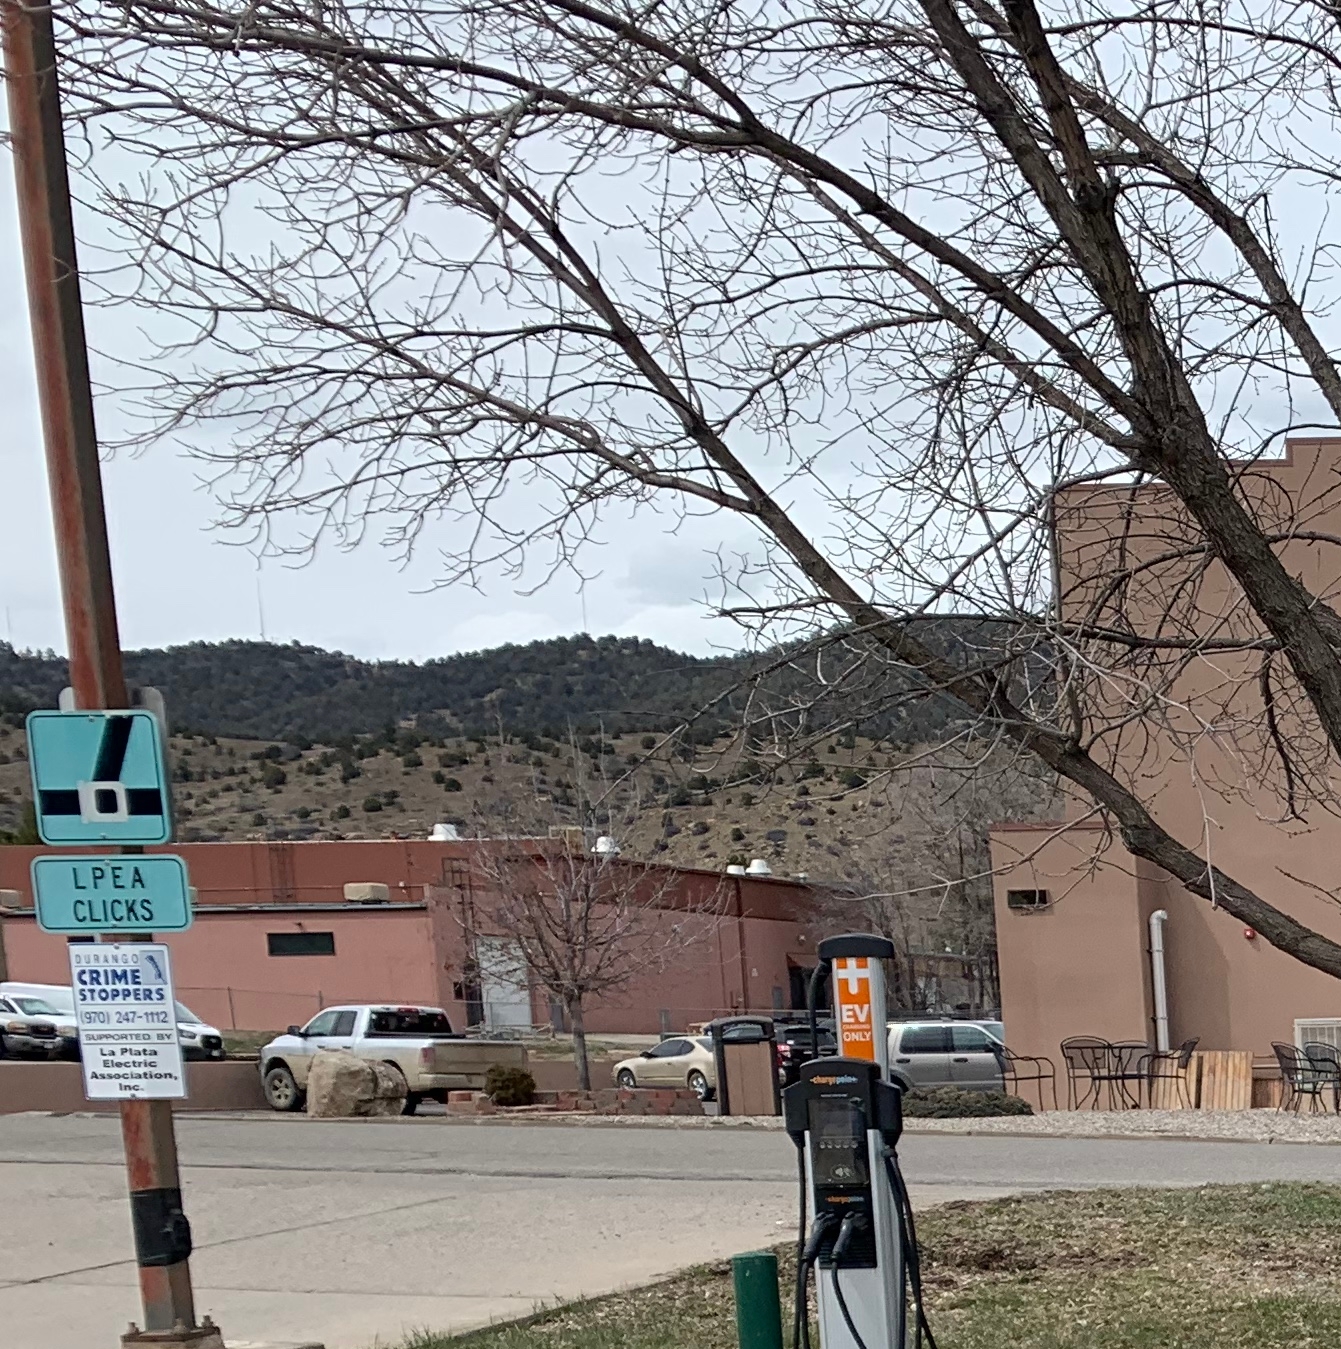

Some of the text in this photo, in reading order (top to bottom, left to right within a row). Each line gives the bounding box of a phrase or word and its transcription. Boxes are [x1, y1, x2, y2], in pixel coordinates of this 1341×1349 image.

[72, 866, 145, 890] LPEA
[73, 899, 154, 922] CLICKS
[75, 954, 139, 964] DURANGO
[77, 968, 141, 986] CRIME
[79, 988, 165, 1001] STOPPERS
[81, 1010, 168, 1024] (970) 247-1112
[841, 1003, 869, 1023] EV
[84, 1033, 173, 1041] SUPPORTED BY
[843, 1031, 871, 1041] ONLY
[100, 1047, 158, 1057] La Plata
[102, 1059, 158, 1068] Electric
[90, 1071, 178, 1081] Association,
[118, 1082, 145, 1092] Inc.
